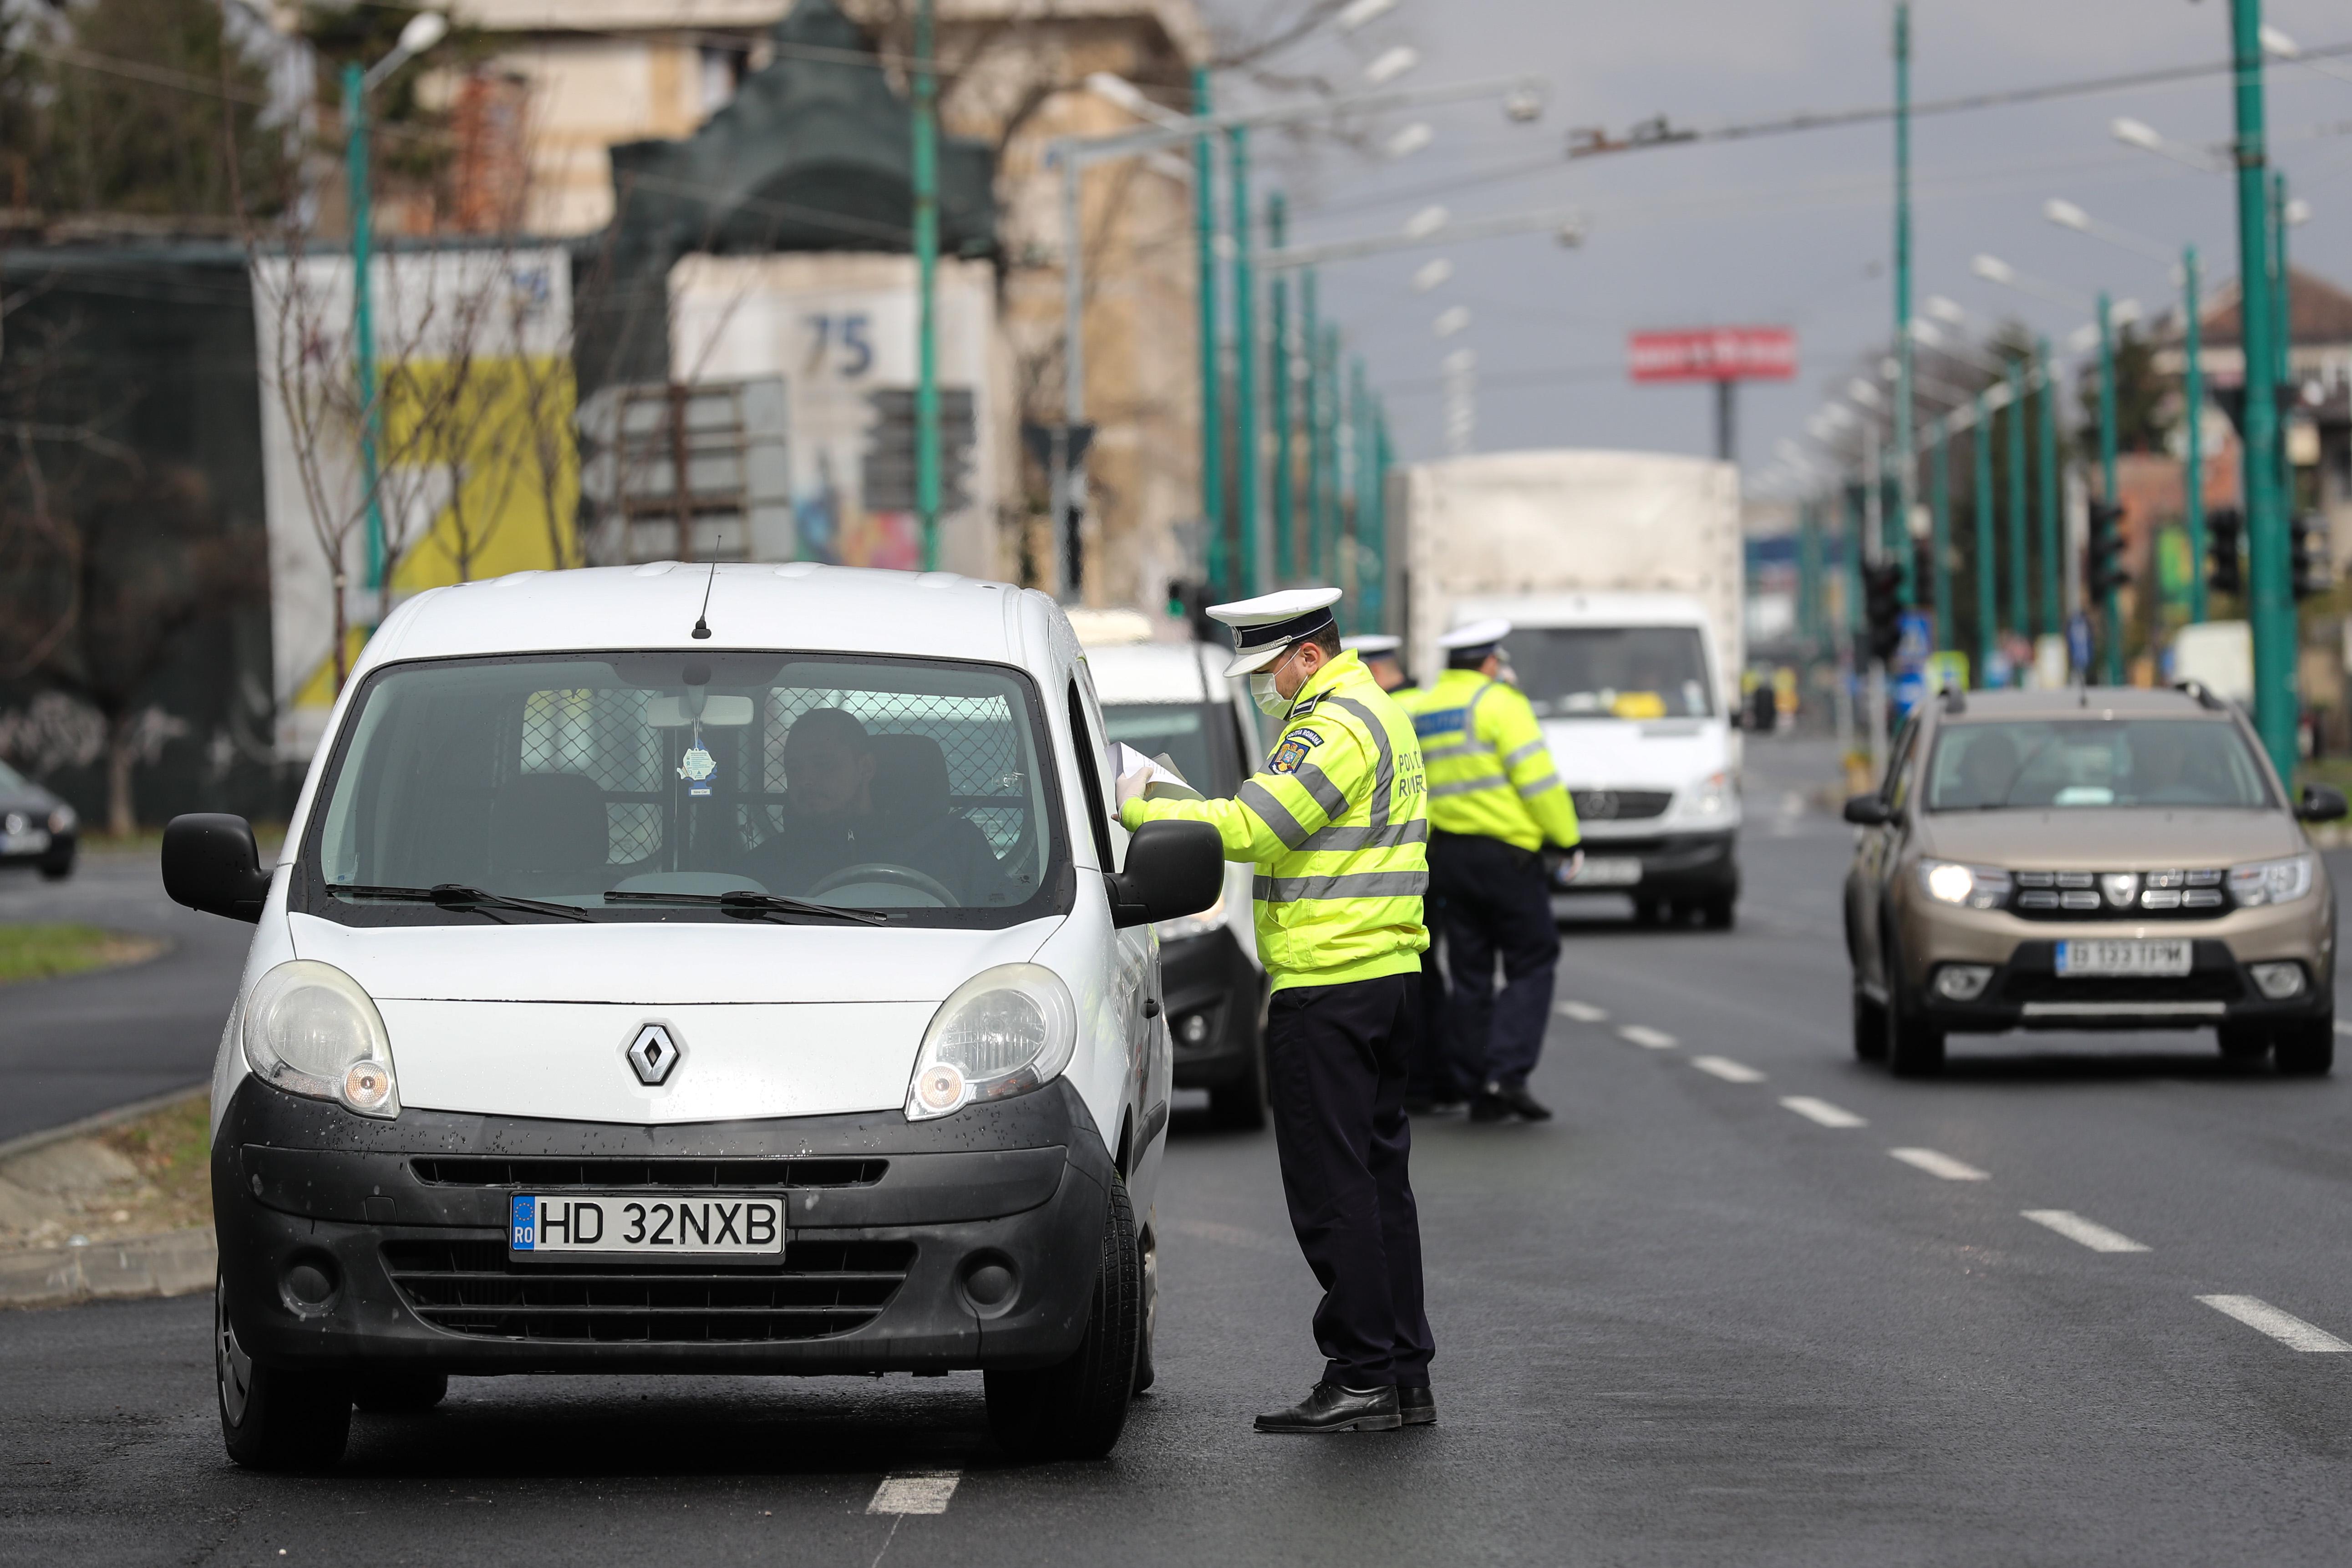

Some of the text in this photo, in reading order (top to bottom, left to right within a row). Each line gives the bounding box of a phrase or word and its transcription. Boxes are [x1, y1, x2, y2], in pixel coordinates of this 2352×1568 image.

[803, 313, 874, 379] 75
[514, 1227, 533, 1243] RO
[540, 1202, 603, 1243] HD
